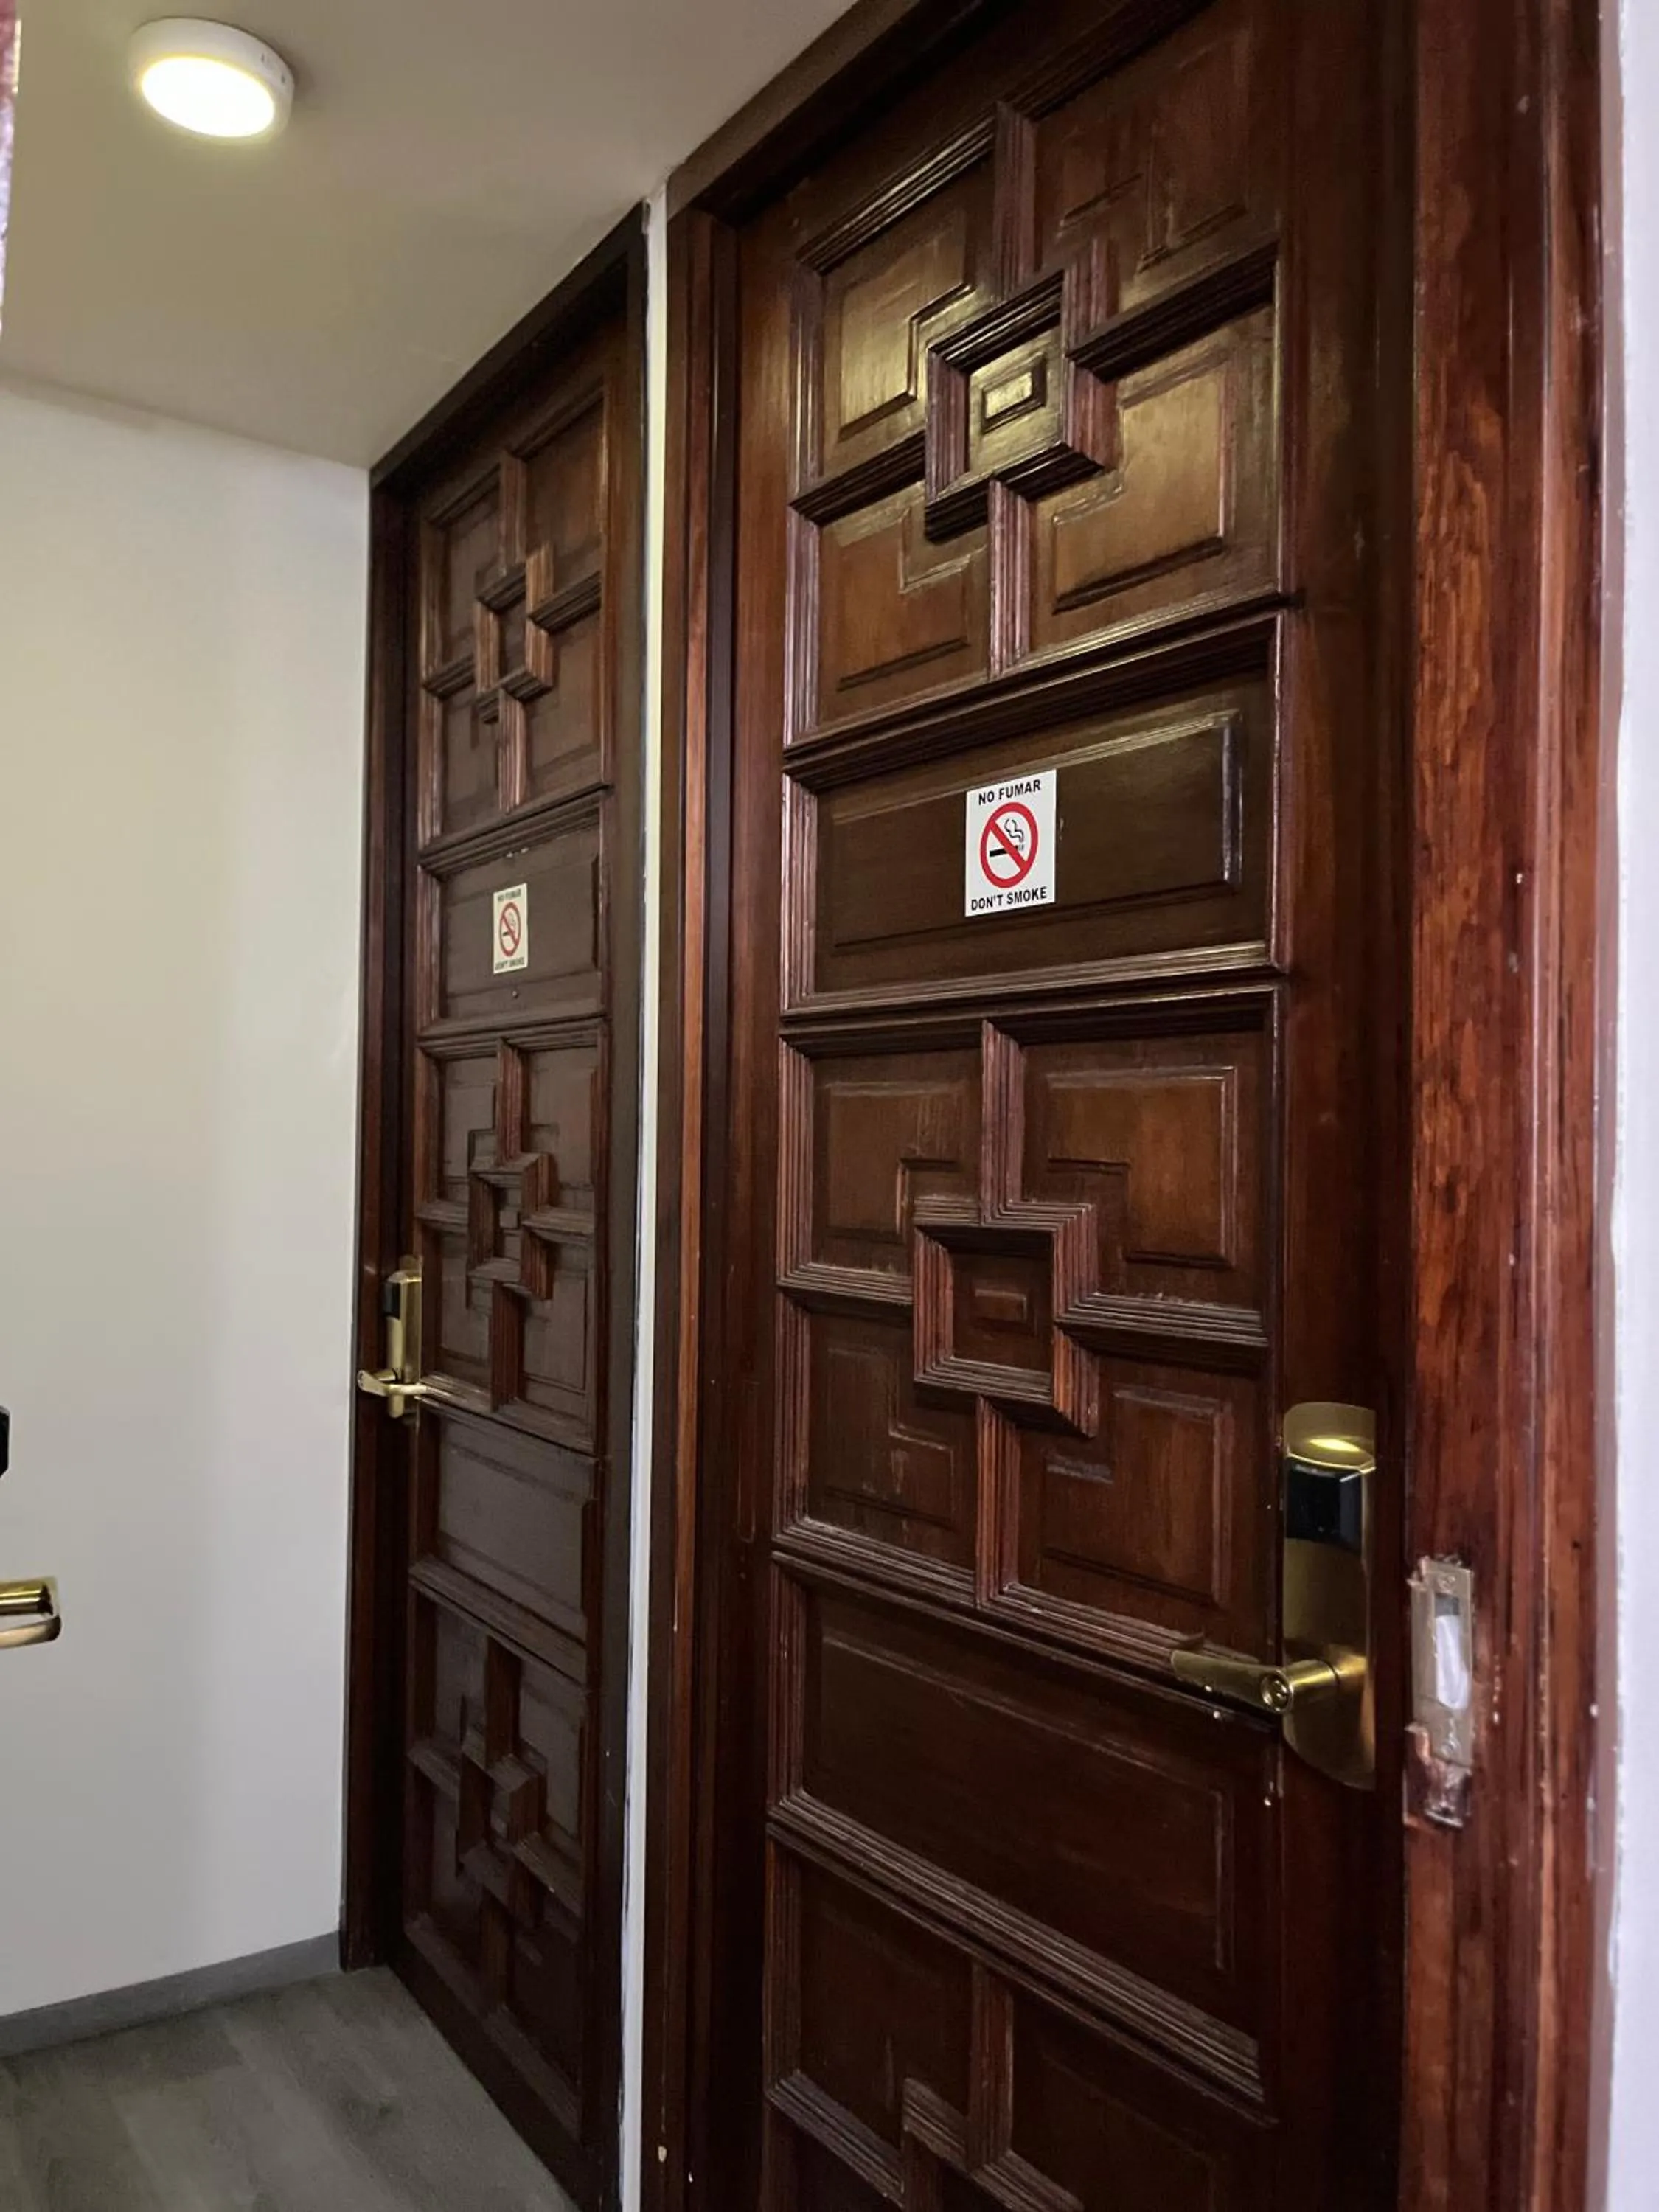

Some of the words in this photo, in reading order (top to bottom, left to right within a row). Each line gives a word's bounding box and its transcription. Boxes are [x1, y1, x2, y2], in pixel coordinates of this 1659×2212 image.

[978, 790, 995, 805] NO
[998, 779, 1041, 800] FUMAR
[971, 894, 1004, 911] DON'T
[1006, 886, 1047, 905] SMOKE
